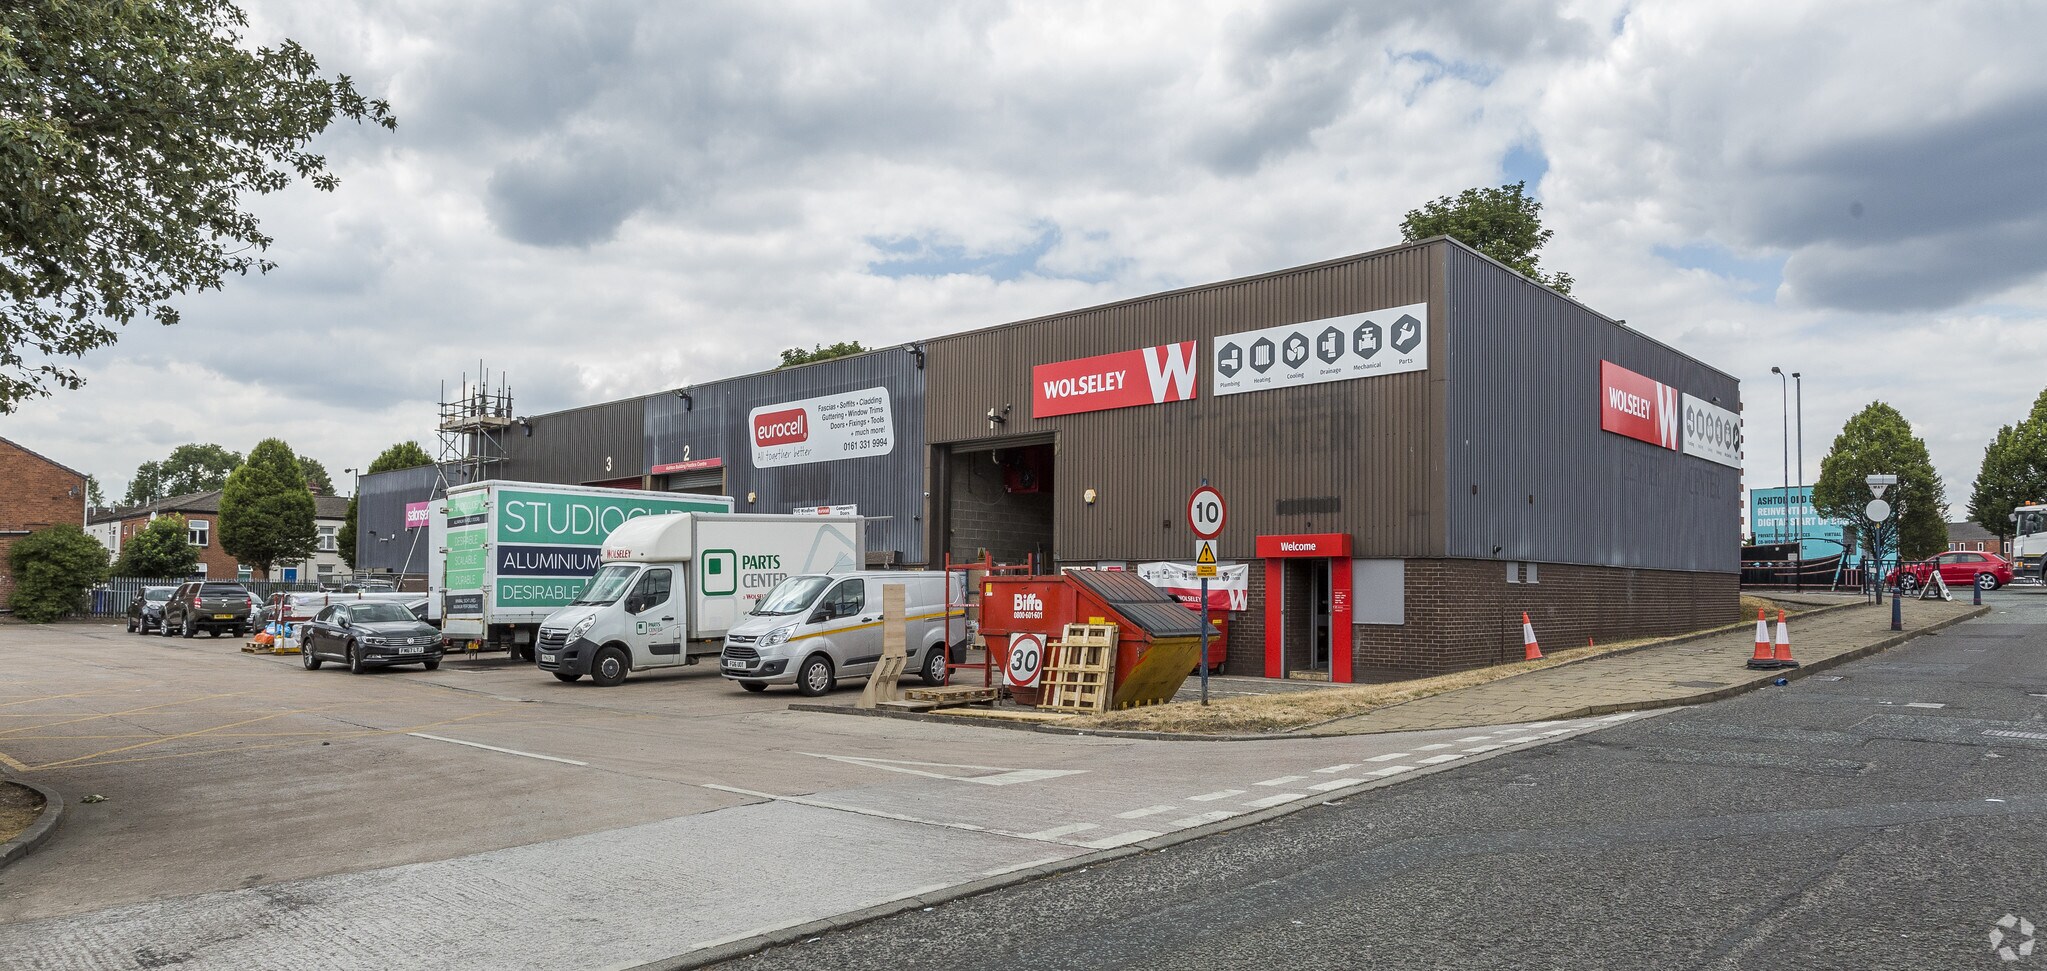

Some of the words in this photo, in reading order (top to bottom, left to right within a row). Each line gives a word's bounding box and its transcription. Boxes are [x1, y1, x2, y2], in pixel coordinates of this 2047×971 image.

[1353, 361, 1382, 371] Mechanical
[1399, 357, 1413, 365] Parts
[1286, 371, 1304, 380] Cooling
[1320, 367, 1342, 376] Drainage
[1043, 370, 1126, 400] WOLSELEY
[1220, 380, 1241, 388] Plumbing
[1253, 376, 1272, 384] Heating
[818, 404, 836, 412] Fascias
[840, 401, 856, 409] Soffits
[859, 396, 883, 406] Cladding
[1608, 386, 1651, 420] WOLSELEY
[821, 412, 845, 422] Guttering
[847, 409, 868, 418] Window
[757, 415, 803, 440] eurocell
[830, 422, 845, 430] Doors
[848, 419, 867, 428] Fixings
[871, 417, 885, 425] Tools
[870, 426, 886, 434] more!
[843, 441, 858, 451] 0161
[859, 440, 871, 450] 331
[872, 437, 888, 448] 9994
[683, 444, 690, 462] 2
[765, 449, 791, 462] together
[793, 447, 812, 458] better
[605, 456, 612, 472] 3
[505, 501, 690, 535] STUDIO
[1196, 501, 1219, 523] 10
[607, 549, 632, 558] WOLSELEY
[1280, 541, 1316, 551] Welcome
[454, 555, 477, 566] SCALABLE
[503, 552, 600, 570] ALUMINIUM
[742, 554, 781, 570] PARTS
[502, 585, 581, 600] DESIRABLE
[1013, 593, 1043, 611] Biffa
[1011, 649, 1038, 672] 30
